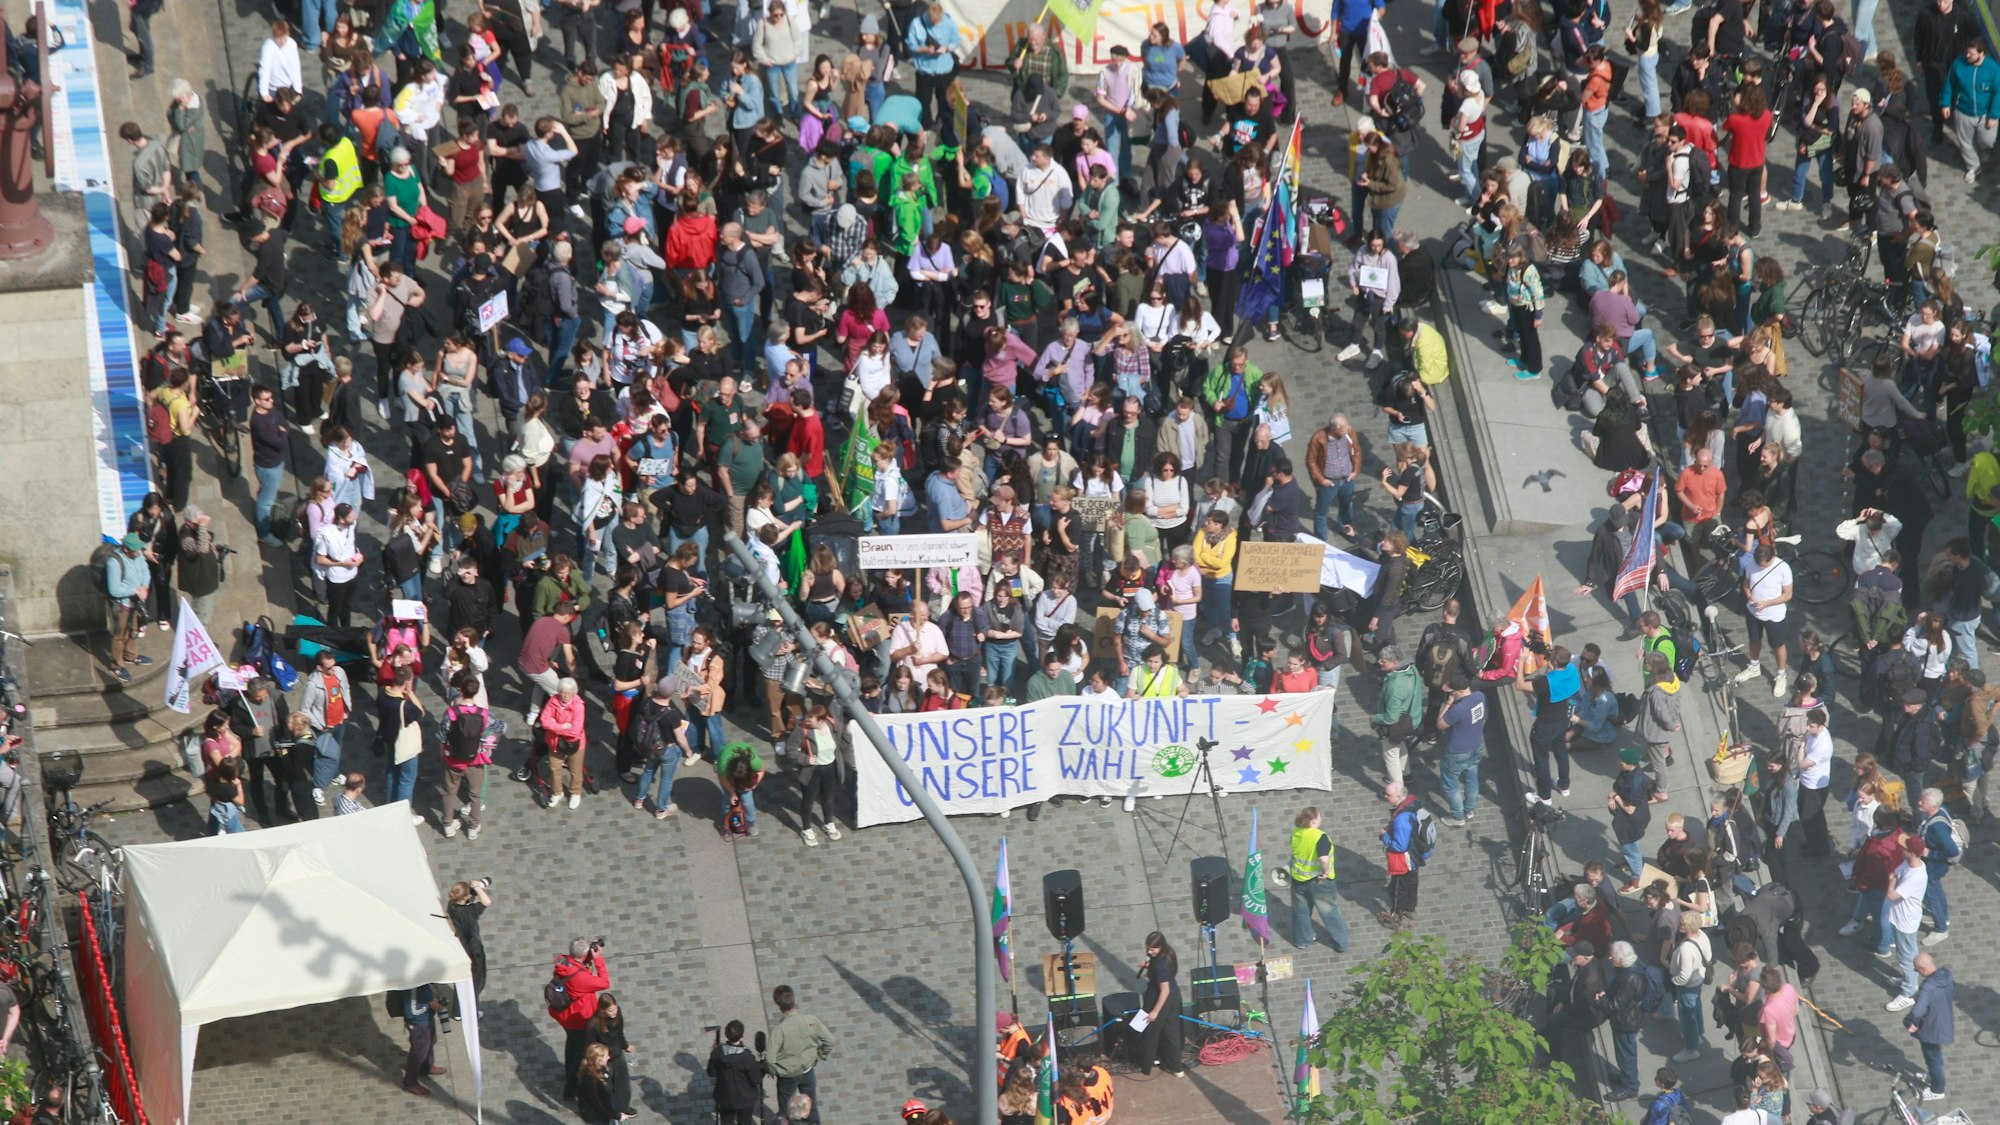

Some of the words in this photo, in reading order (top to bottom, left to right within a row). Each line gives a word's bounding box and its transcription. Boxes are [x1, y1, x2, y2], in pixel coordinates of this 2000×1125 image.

[1088, 499, 1121, 510] OCEANS
[861, 541, 893, 552] Braun
[887, 709, 1035, 762] UNSERE
[1059, 698, 1221, 747] ZUKUNFT
[1058, 747, 1144, 780] WAHL
